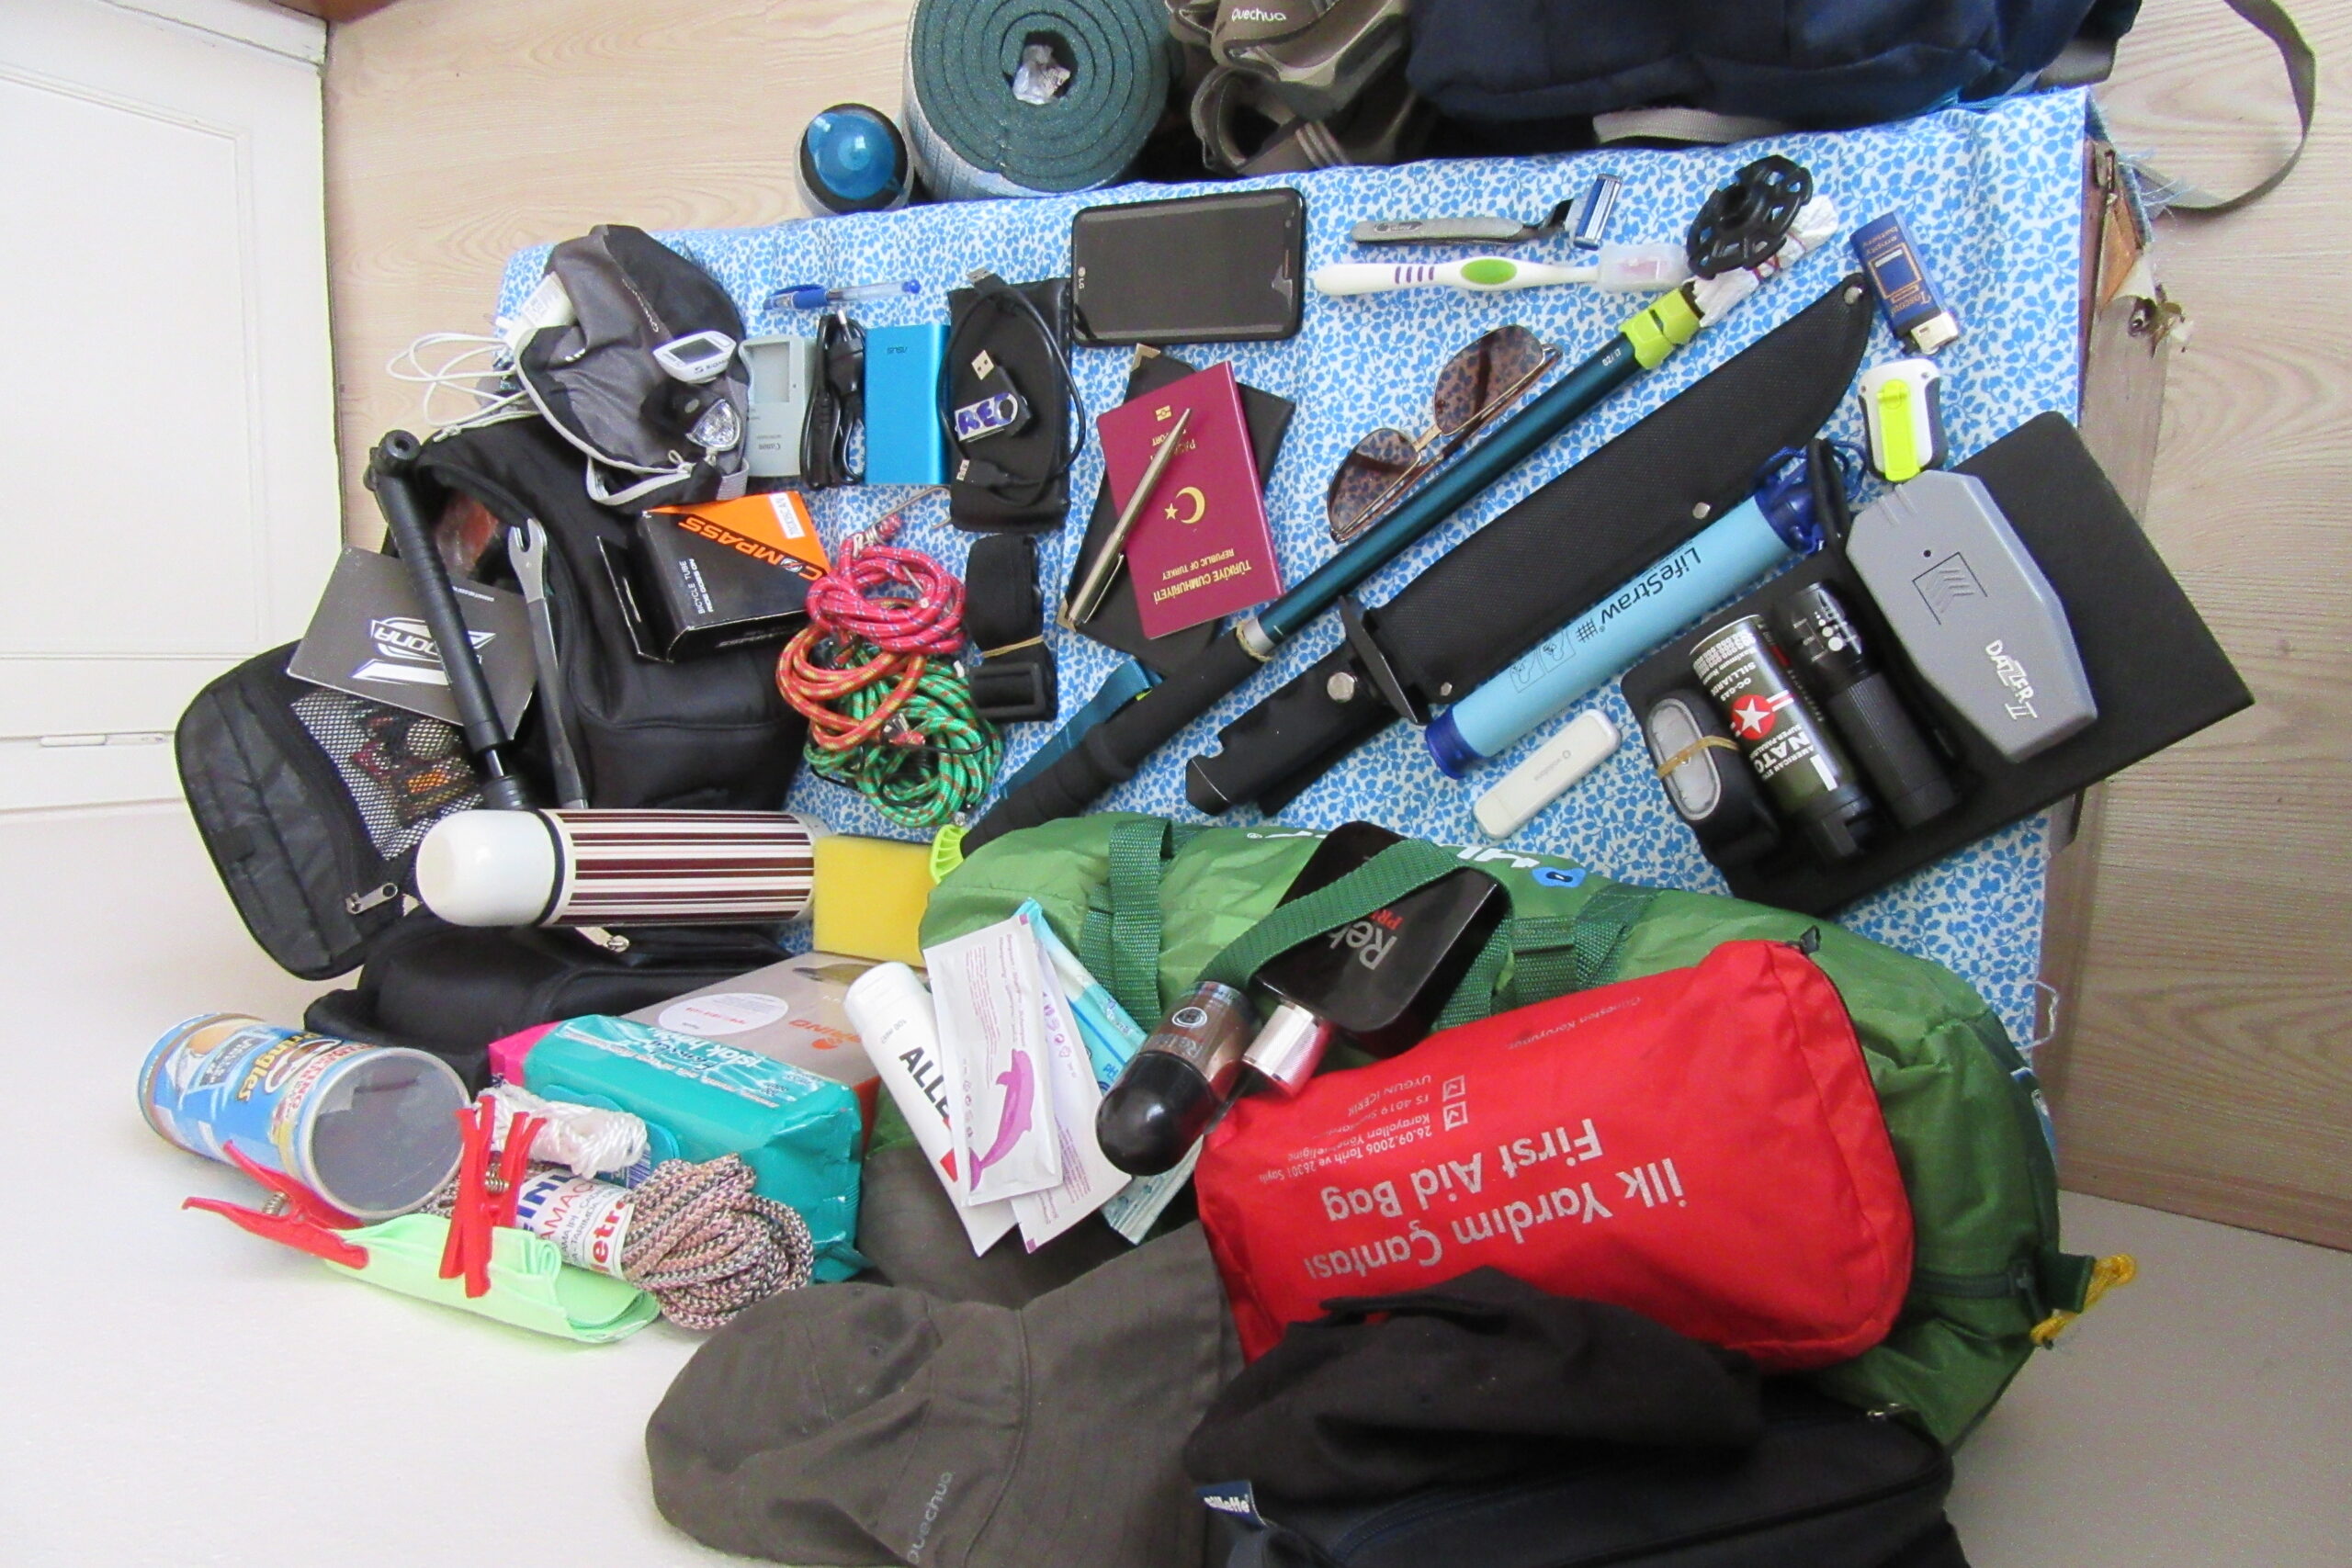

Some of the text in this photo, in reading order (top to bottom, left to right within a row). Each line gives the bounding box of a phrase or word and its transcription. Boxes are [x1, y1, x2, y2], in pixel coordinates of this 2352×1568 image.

[1232, 8, 1286, 22] Quechua
[1079, 277, 1085, 289] LG
[887, 346, 908, 355] ASUS
[678, 516, 823, 581] COMPASS
[1162, 548, 1235, 581] REPUBLIC OF TURKEY
[679, 560, 706, 615] BICYCLE TUBE
[1153, 559, 1251, 604] TÜRKİYE CUMHURİYETİ
[1600, 547, 1702, 622] LifeStraw
[1720, 677, 1751, 702] OC-GAS
[1753, 731, 1811, 774] NATO
[1774, 745, 1815, 772] AMERICAN
[1384, 1075, 1432, 1095] UYGUN
[1381, 1099, 1413, 1116] 4019
[1334, 1146, 1363, 1164] Tarih
[1365, 1124, 1432, 1156] 26.09.2006
[1318, 1155, 1333, 1167] ve
[1320, 1119, 1604, 1222] First Aid Bag
[1451, 1182, 1613, 1244] Yardım
[1304, 1219, 1443, 1280] Çantası
